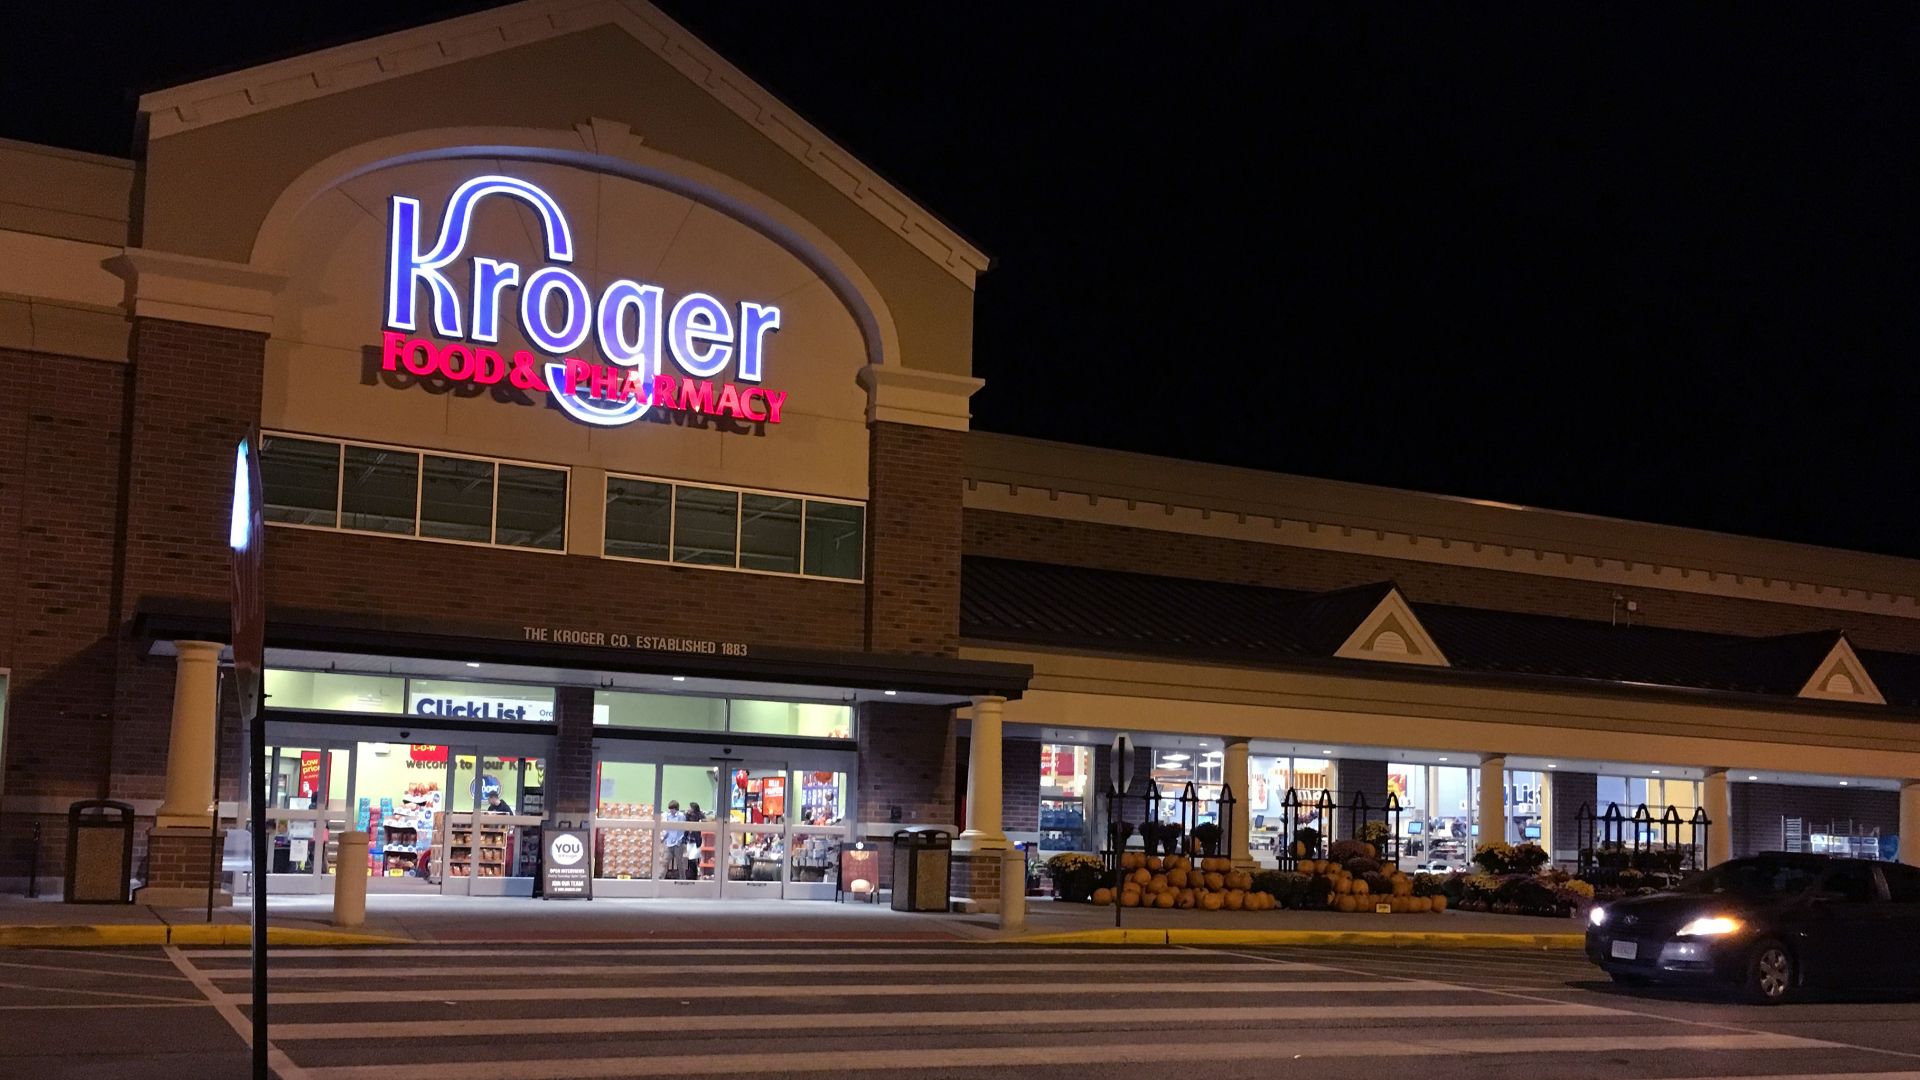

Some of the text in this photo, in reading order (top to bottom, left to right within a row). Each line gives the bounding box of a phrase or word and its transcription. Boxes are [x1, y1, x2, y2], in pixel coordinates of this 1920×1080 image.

[386, 175, 781, 426] Kroger
[382, 331, 787, 423] FOOD & PHARMACY
[523, 626, 748, 656] THE KROGER CO. ESTABLISHED 1883
[416, 698, 527, 721] ClickList
[301, 759, 319, 767] Low
[406, 759, 457, 770] welcom
[460, 759, 473, 770] to
[482, 761, 505, 771] our
[555, 843, 580, 854] YOU
